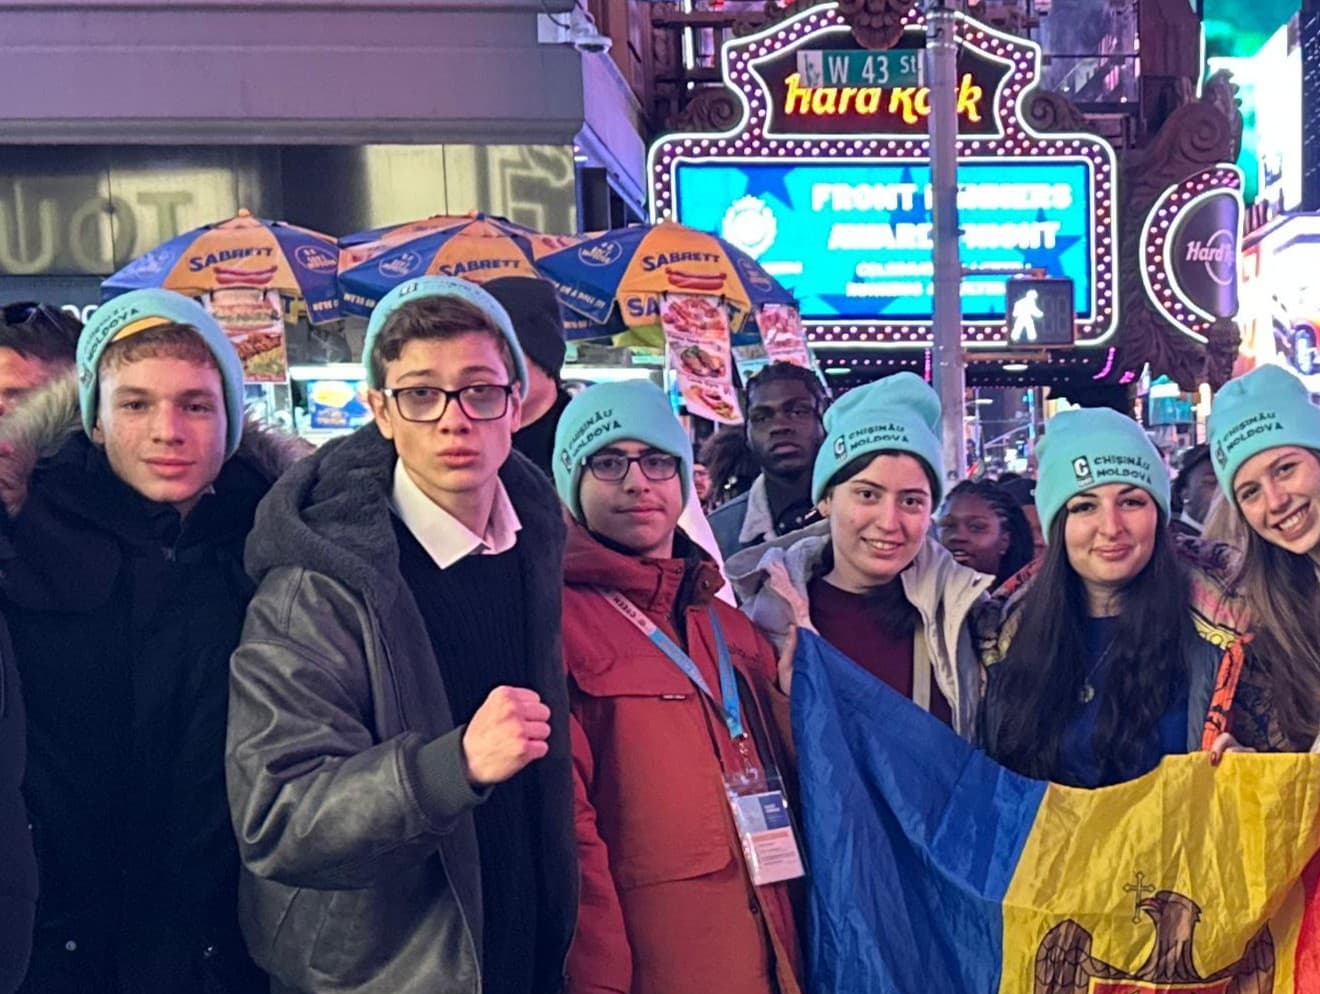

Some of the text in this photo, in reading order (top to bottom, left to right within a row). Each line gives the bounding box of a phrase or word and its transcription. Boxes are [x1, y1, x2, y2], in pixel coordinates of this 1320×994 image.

[828, 55, 917, 84] W 43 St
[189, 248, 273, 272] SABRETT
[1186, 241, 1224, 261] Hard
[439, 259, 521, 277] SABRETT
[642, 251, 720, 272] SABRETT
[850, 434, 909, 450] MOLDOVA
[1227, 421, 1284, 453] MOLDOVA
[1096, 467, 1152, 485] MOLDOVA
